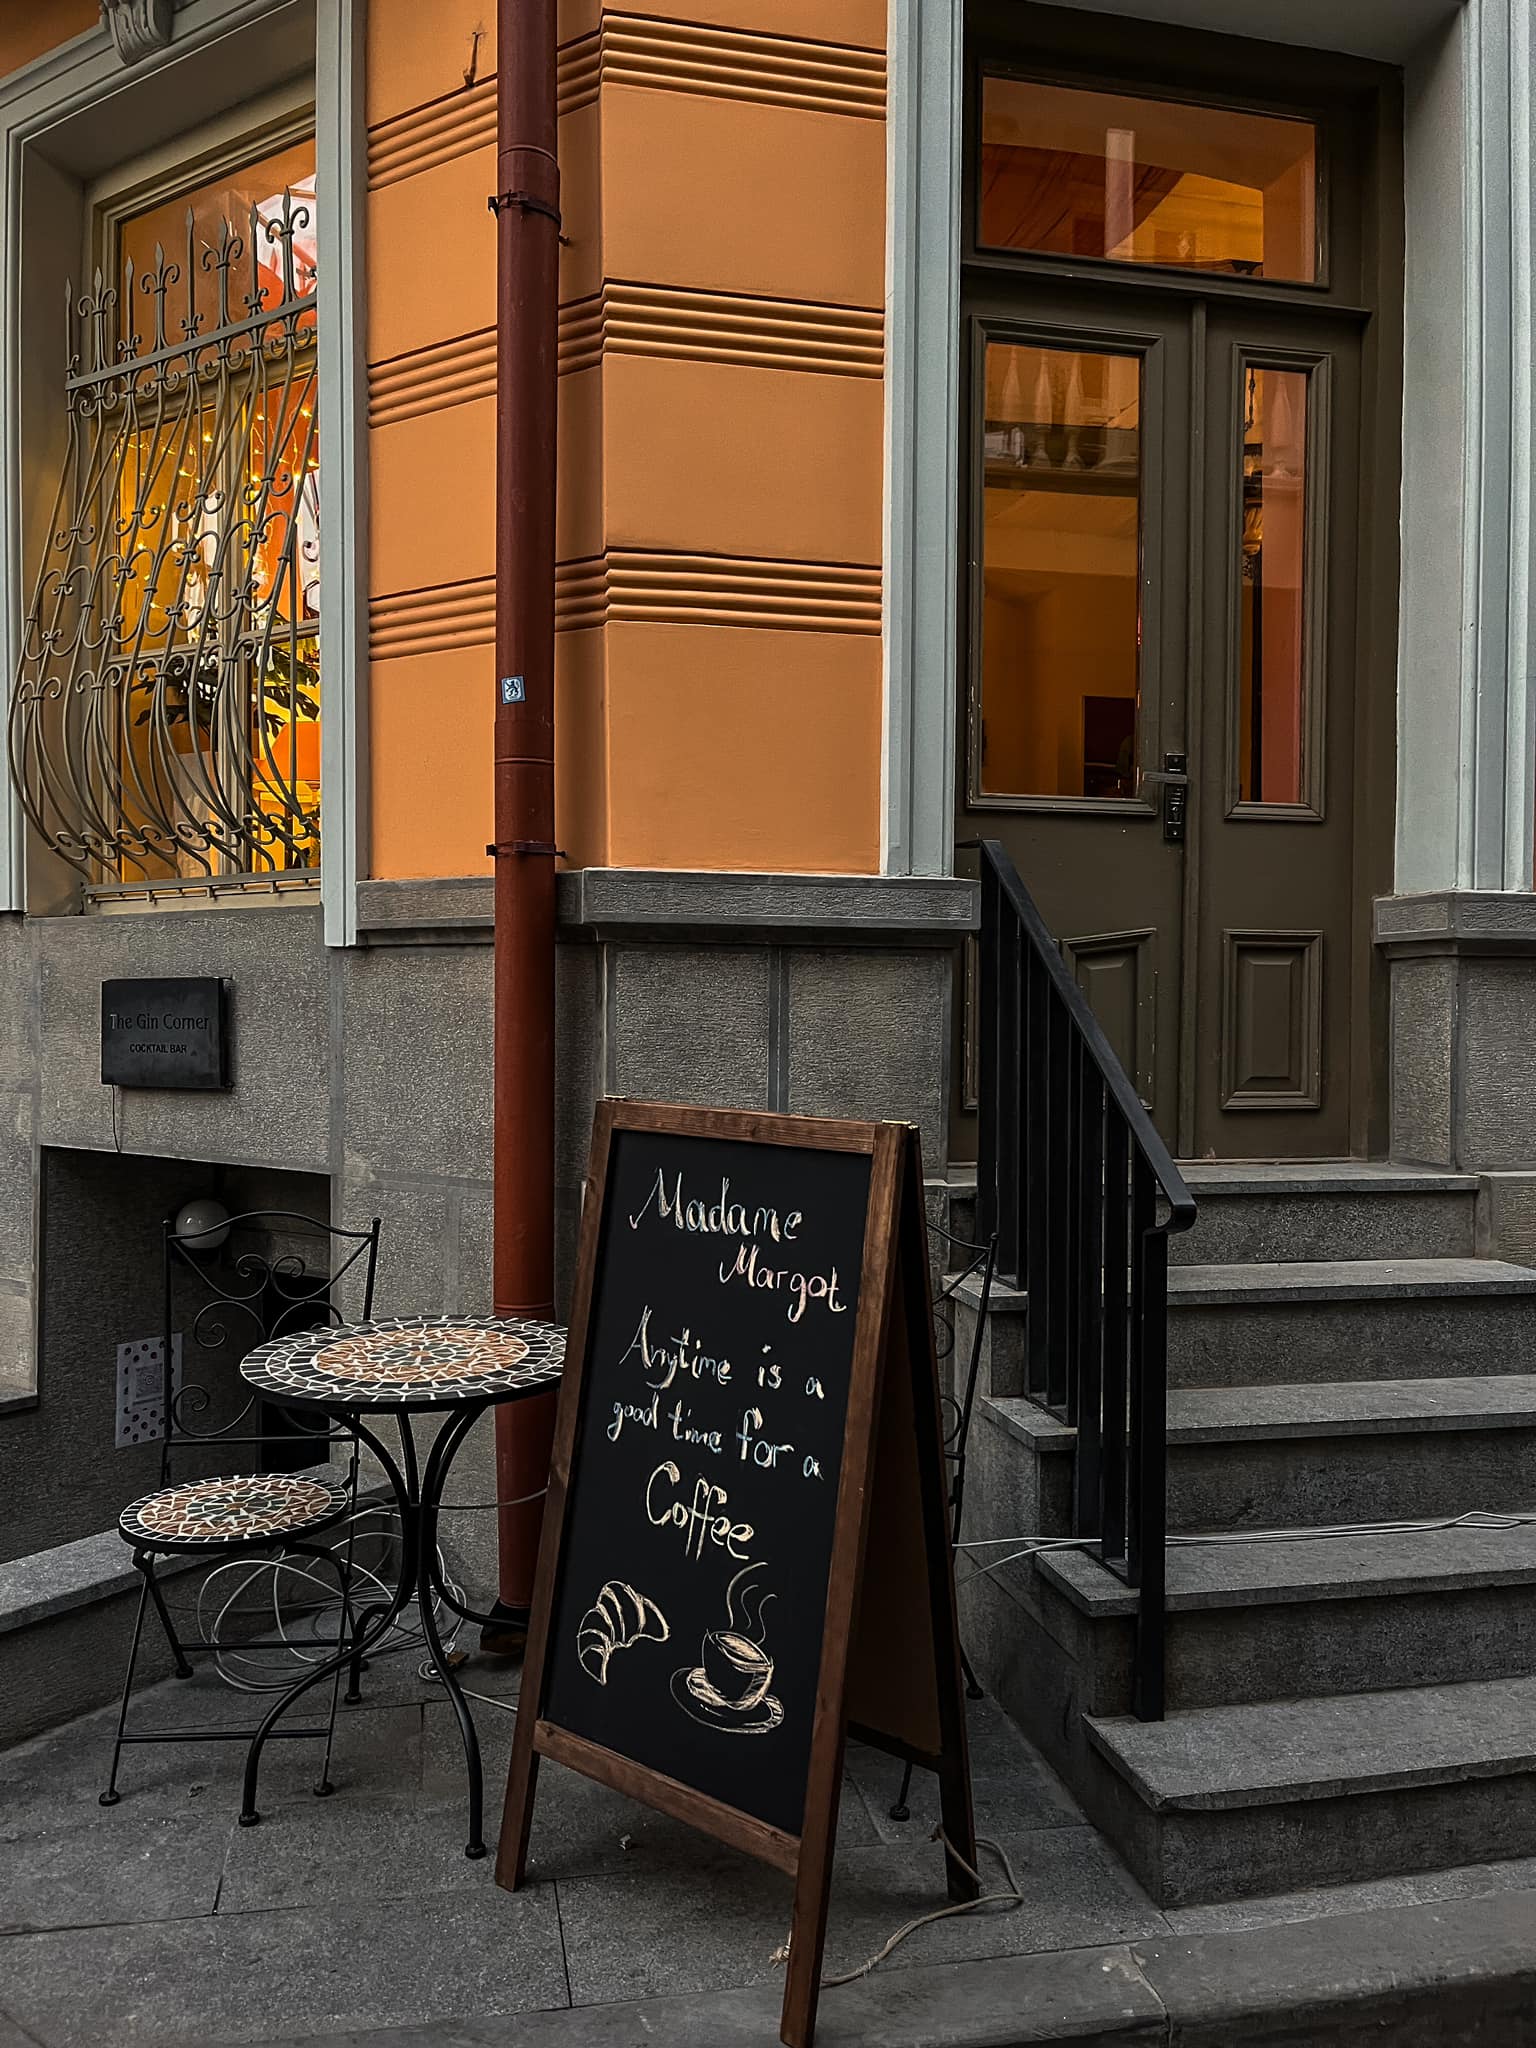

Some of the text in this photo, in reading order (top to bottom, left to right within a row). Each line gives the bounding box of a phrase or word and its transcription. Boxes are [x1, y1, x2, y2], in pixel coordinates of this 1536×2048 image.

[110, 1013, 209, 1030] The Gin Corner
[129, 1044, 187, 1054] COCKTAIL BAR
[629, 1168, 802, 1242] Madame
[719, 1242, 847, 1322] Margot
[618, 1305, 825, 1400] Anytime is a
[606, 1392, 824, 1480] good time for a
[646, 1461, 754, 1560] Coffee
